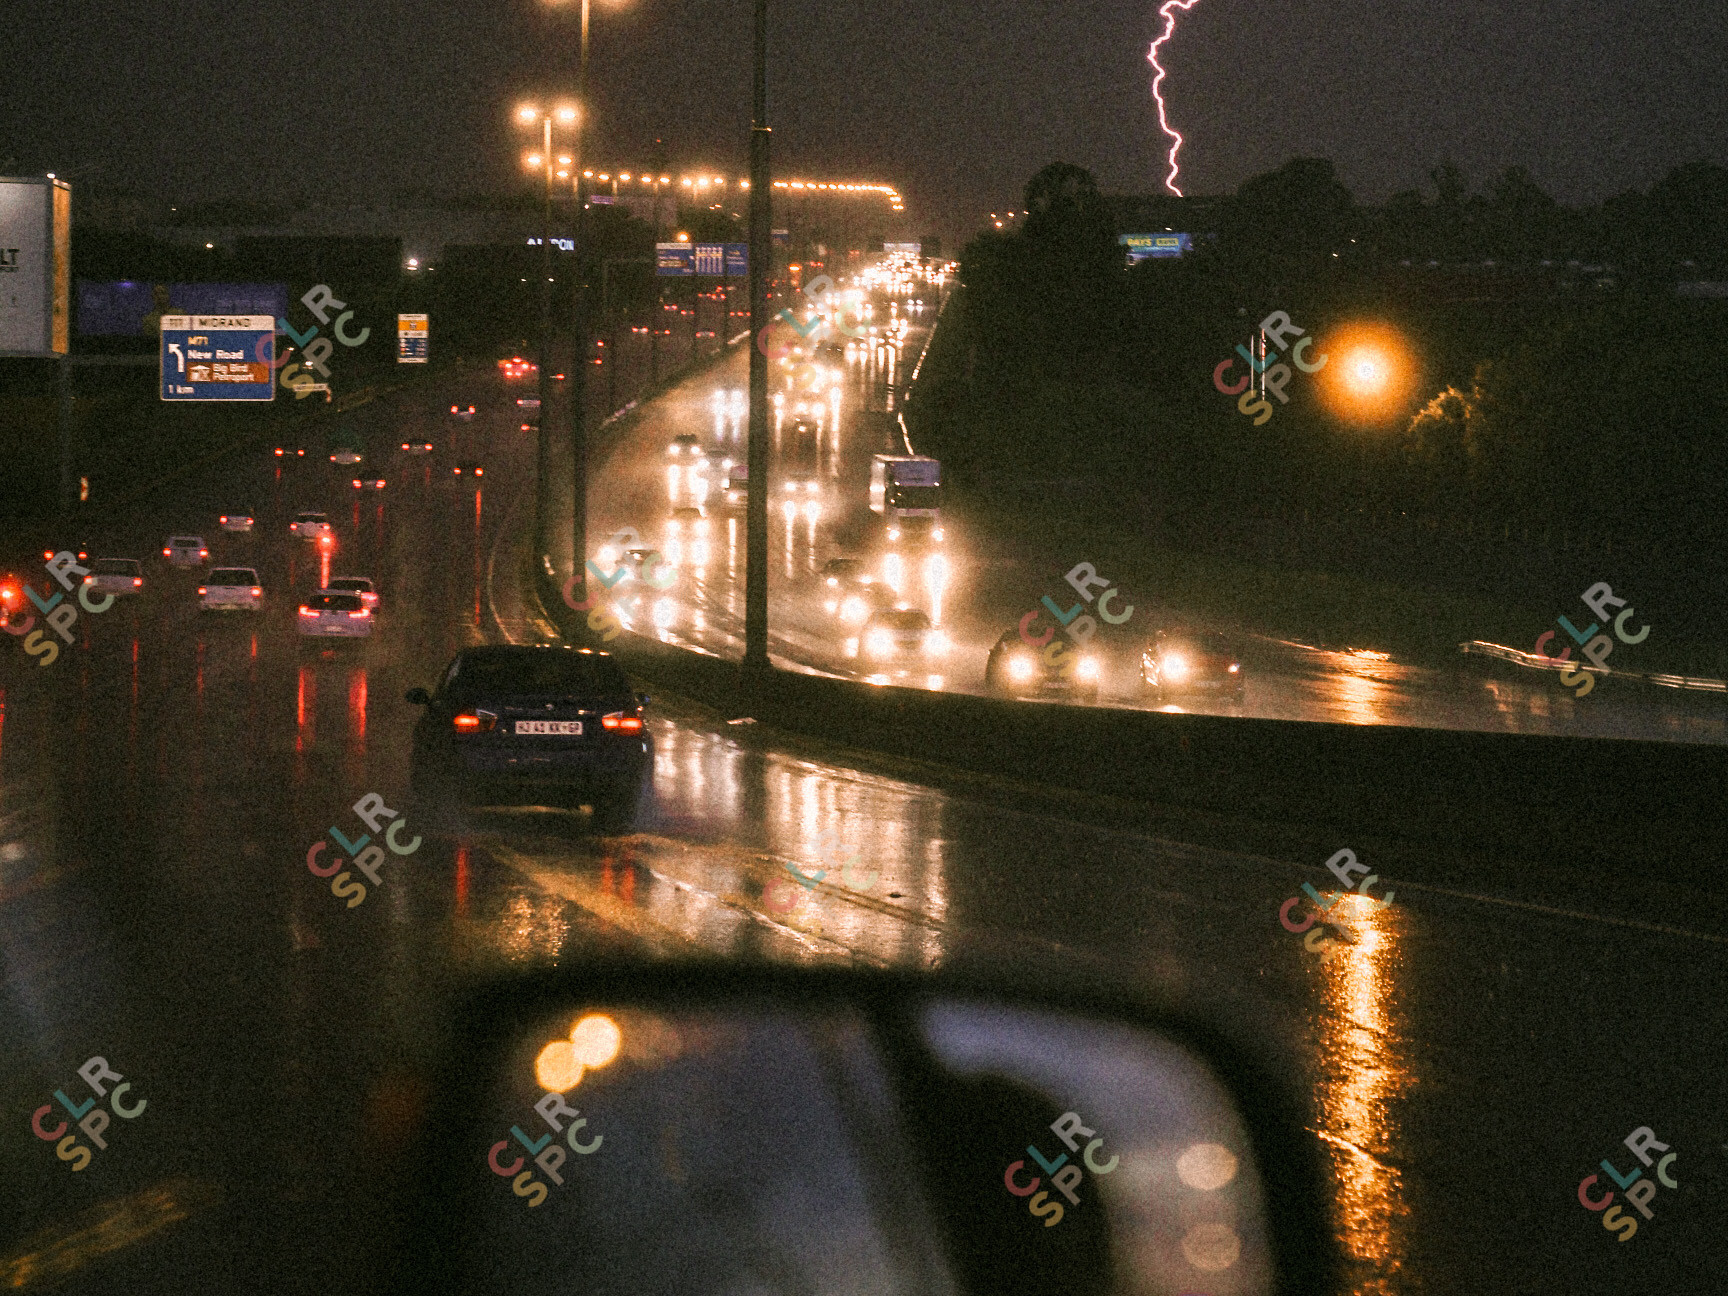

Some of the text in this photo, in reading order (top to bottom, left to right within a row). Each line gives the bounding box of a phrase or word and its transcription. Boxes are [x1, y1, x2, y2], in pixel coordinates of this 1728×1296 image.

[199, 318, 251, 327] MIDRAND
[187, 349, 244, 360] New Road
[212, 364, 248, 375] Big Bird
[168, 385, 195, 394] 1 km
